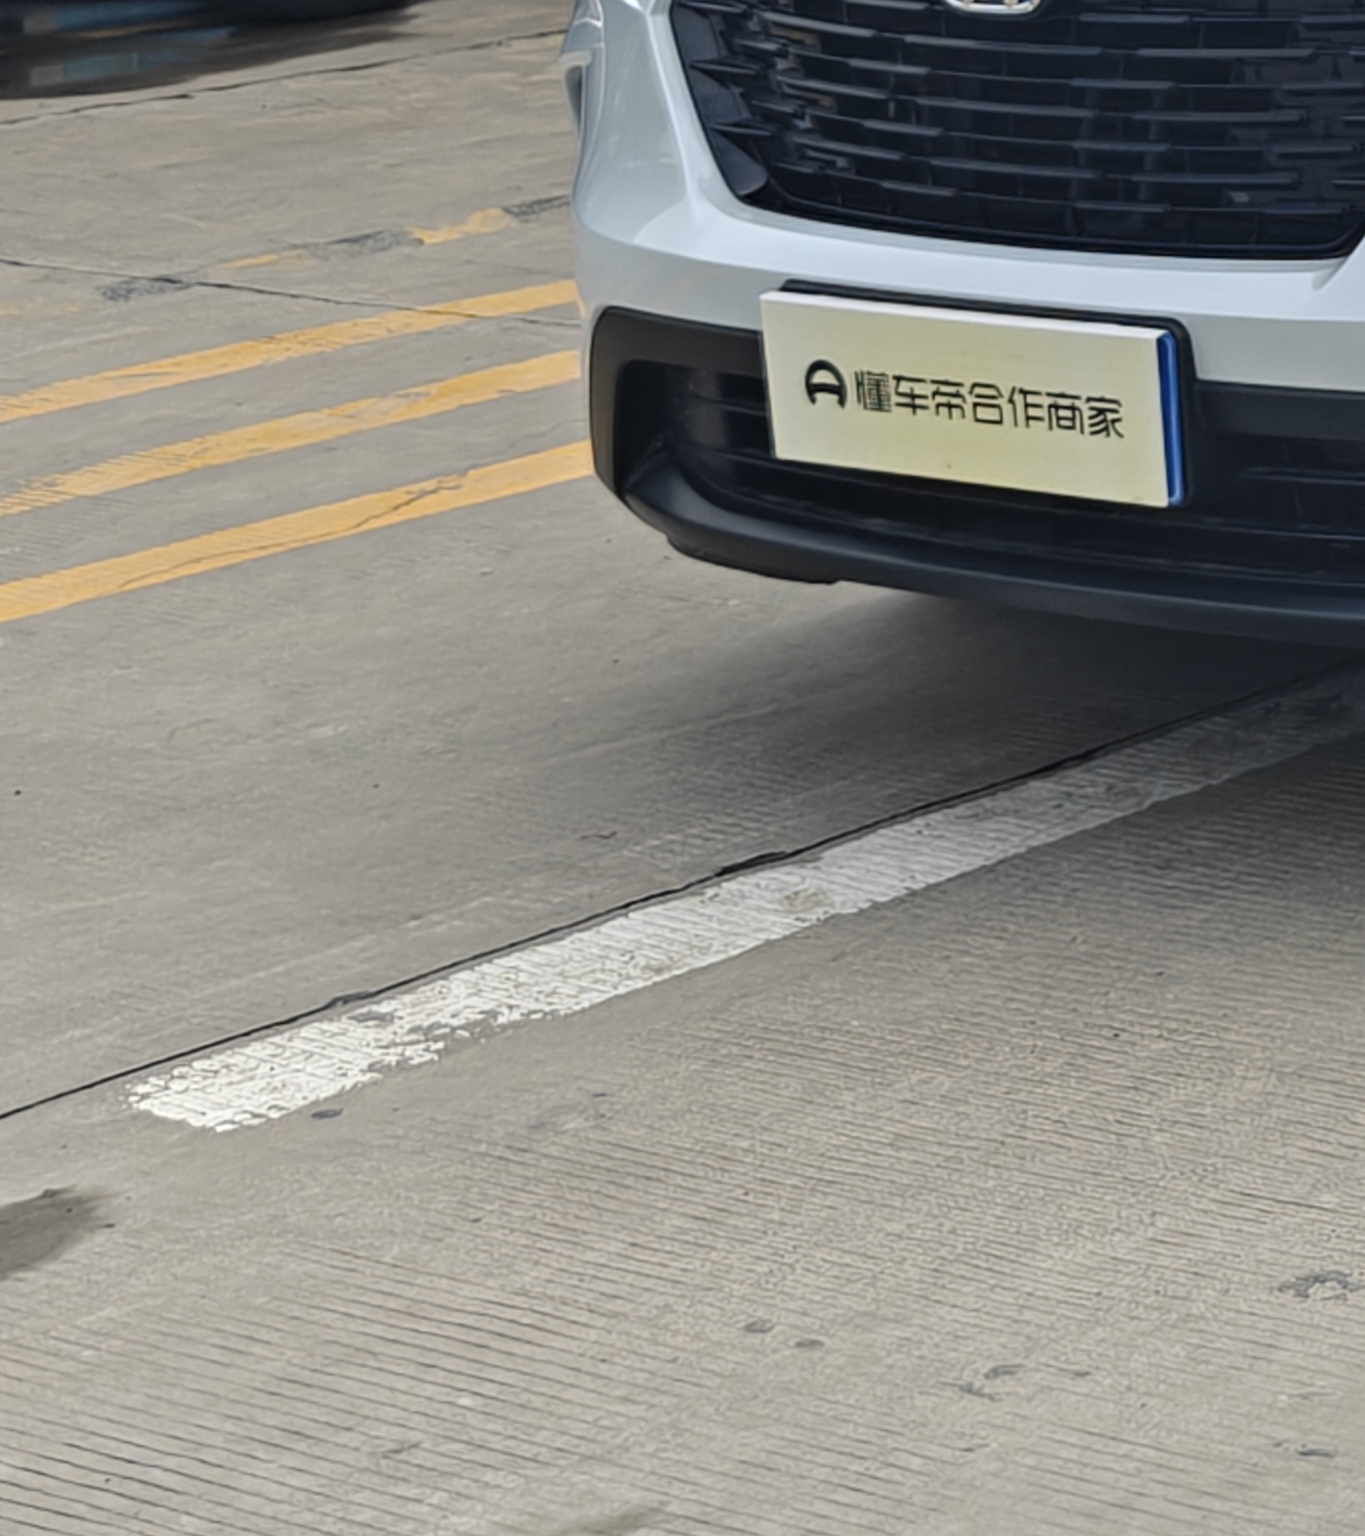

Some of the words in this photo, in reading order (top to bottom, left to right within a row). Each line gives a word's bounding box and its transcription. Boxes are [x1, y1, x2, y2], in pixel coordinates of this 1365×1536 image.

[854, 368, 1124, 439] 懂车帝合作商家
